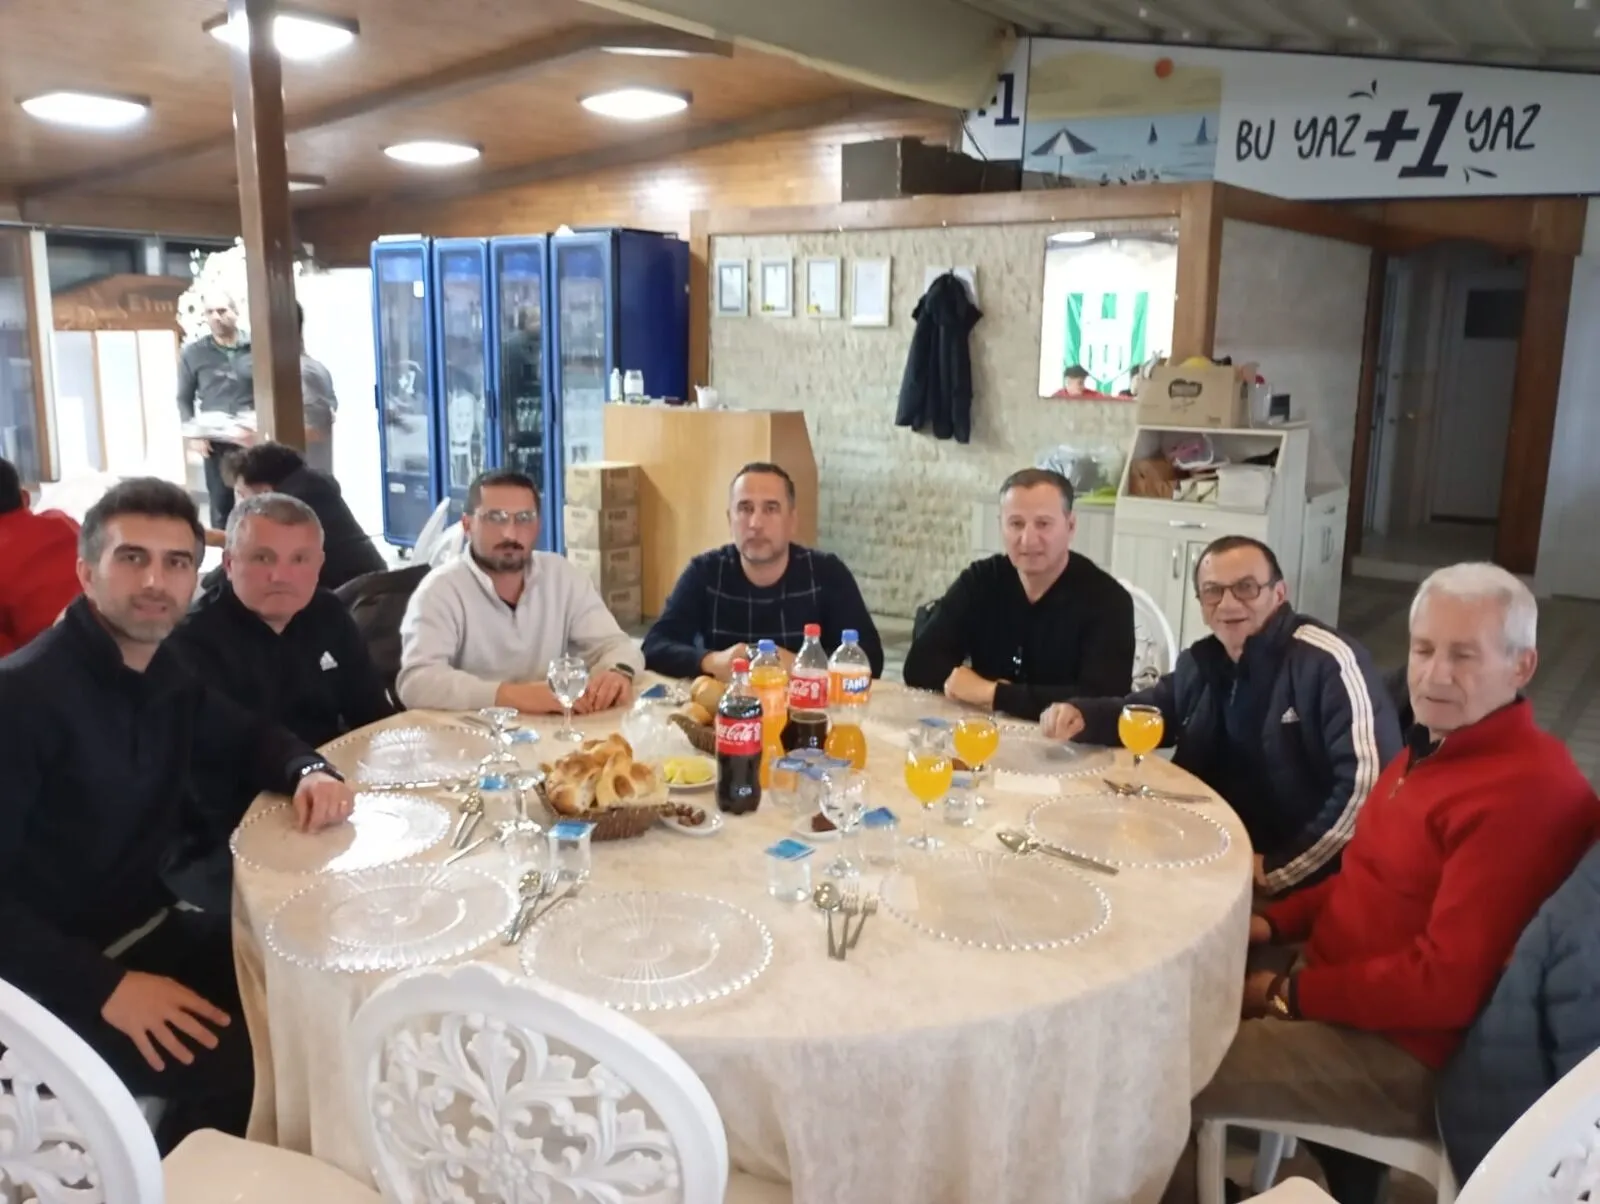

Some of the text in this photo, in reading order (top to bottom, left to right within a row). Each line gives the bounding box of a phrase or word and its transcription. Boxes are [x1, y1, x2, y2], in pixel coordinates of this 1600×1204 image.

[977, 73, 1020, 126] 1
[1236, 91, 1541, 178] BU YAZ +1 YAZ
[841, 675, 869, 692] FANT
